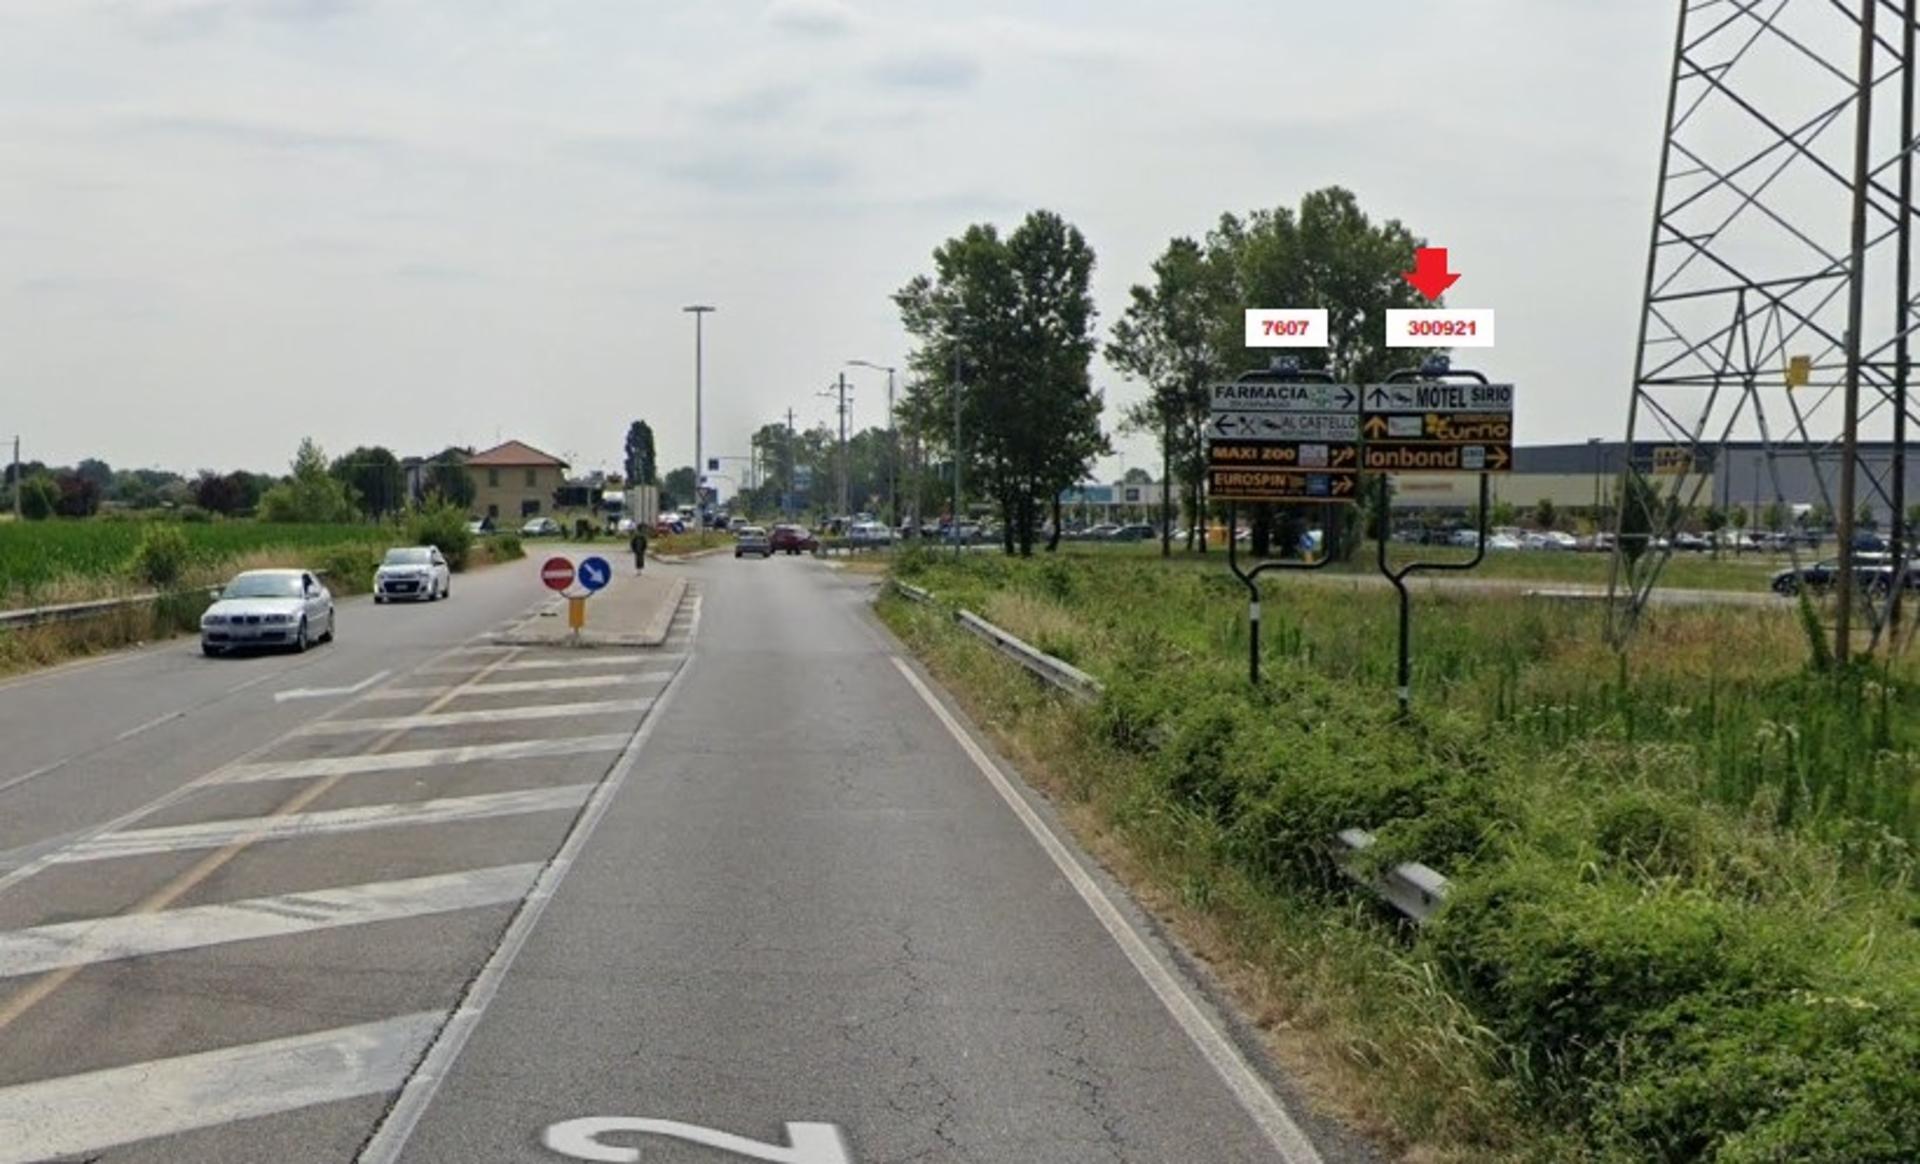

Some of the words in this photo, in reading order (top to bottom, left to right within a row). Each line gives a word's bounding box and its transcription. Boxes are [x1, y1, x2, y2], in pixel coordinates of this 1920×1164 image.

[1214, 385, 1309, 400] FARMACIA
[1416, 386, 1467, 409] MOTEL
[1470, 387, 1511, 403] SIRIO
[1282, 416, 1297, 429] AL
[1299, 416, 1357, 429] CASTELLO
[1212, 446, 1258, 460] MAXI
[1261, 446, 1296, 460] ZOO
[1364, 446, 1458, 467] ionbond
[1214, 472, 1287, 487] EUROSPIN
